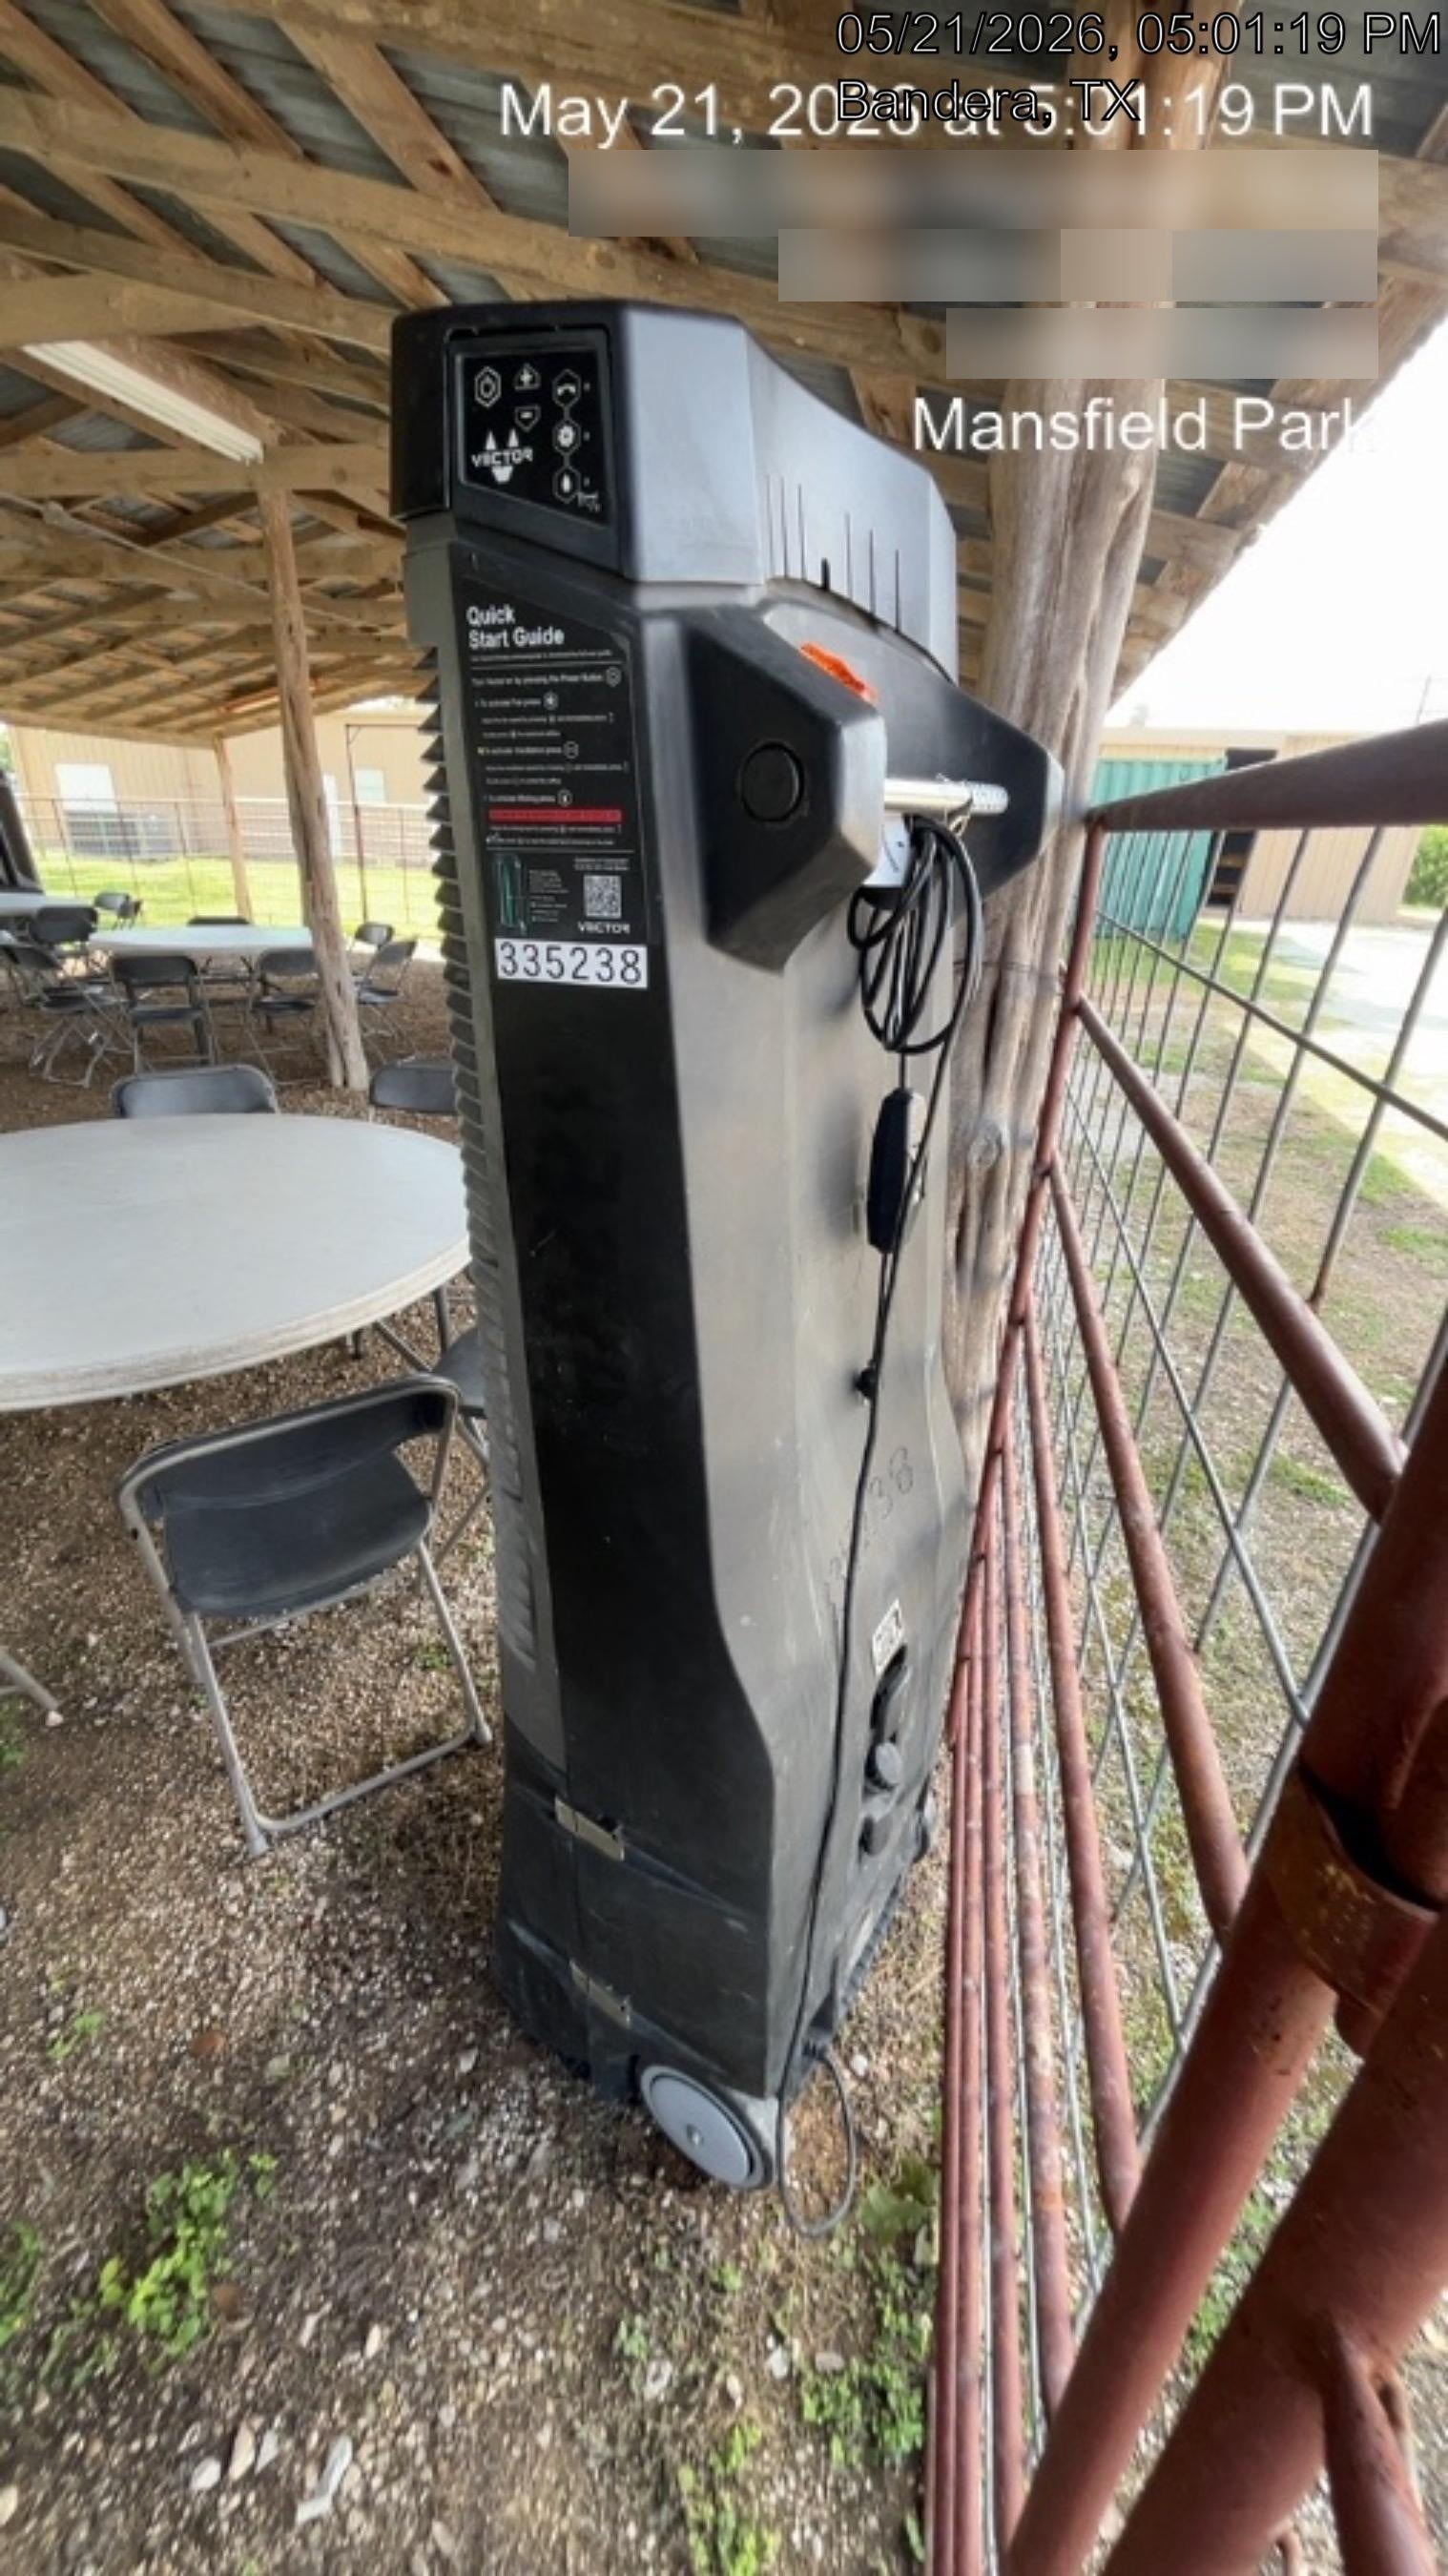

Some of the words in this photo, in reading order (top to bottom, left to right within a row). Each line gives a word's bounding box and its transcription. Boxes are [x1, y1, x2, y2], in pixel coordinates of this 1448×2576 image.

[471, 447, 533, 467] VECTOR
[465, 603, 516, 628] Quick
[468, 629, 510, 650] Start
[512, 625, 565, 648] Guide
[499, 941, 642, 985] 335238
